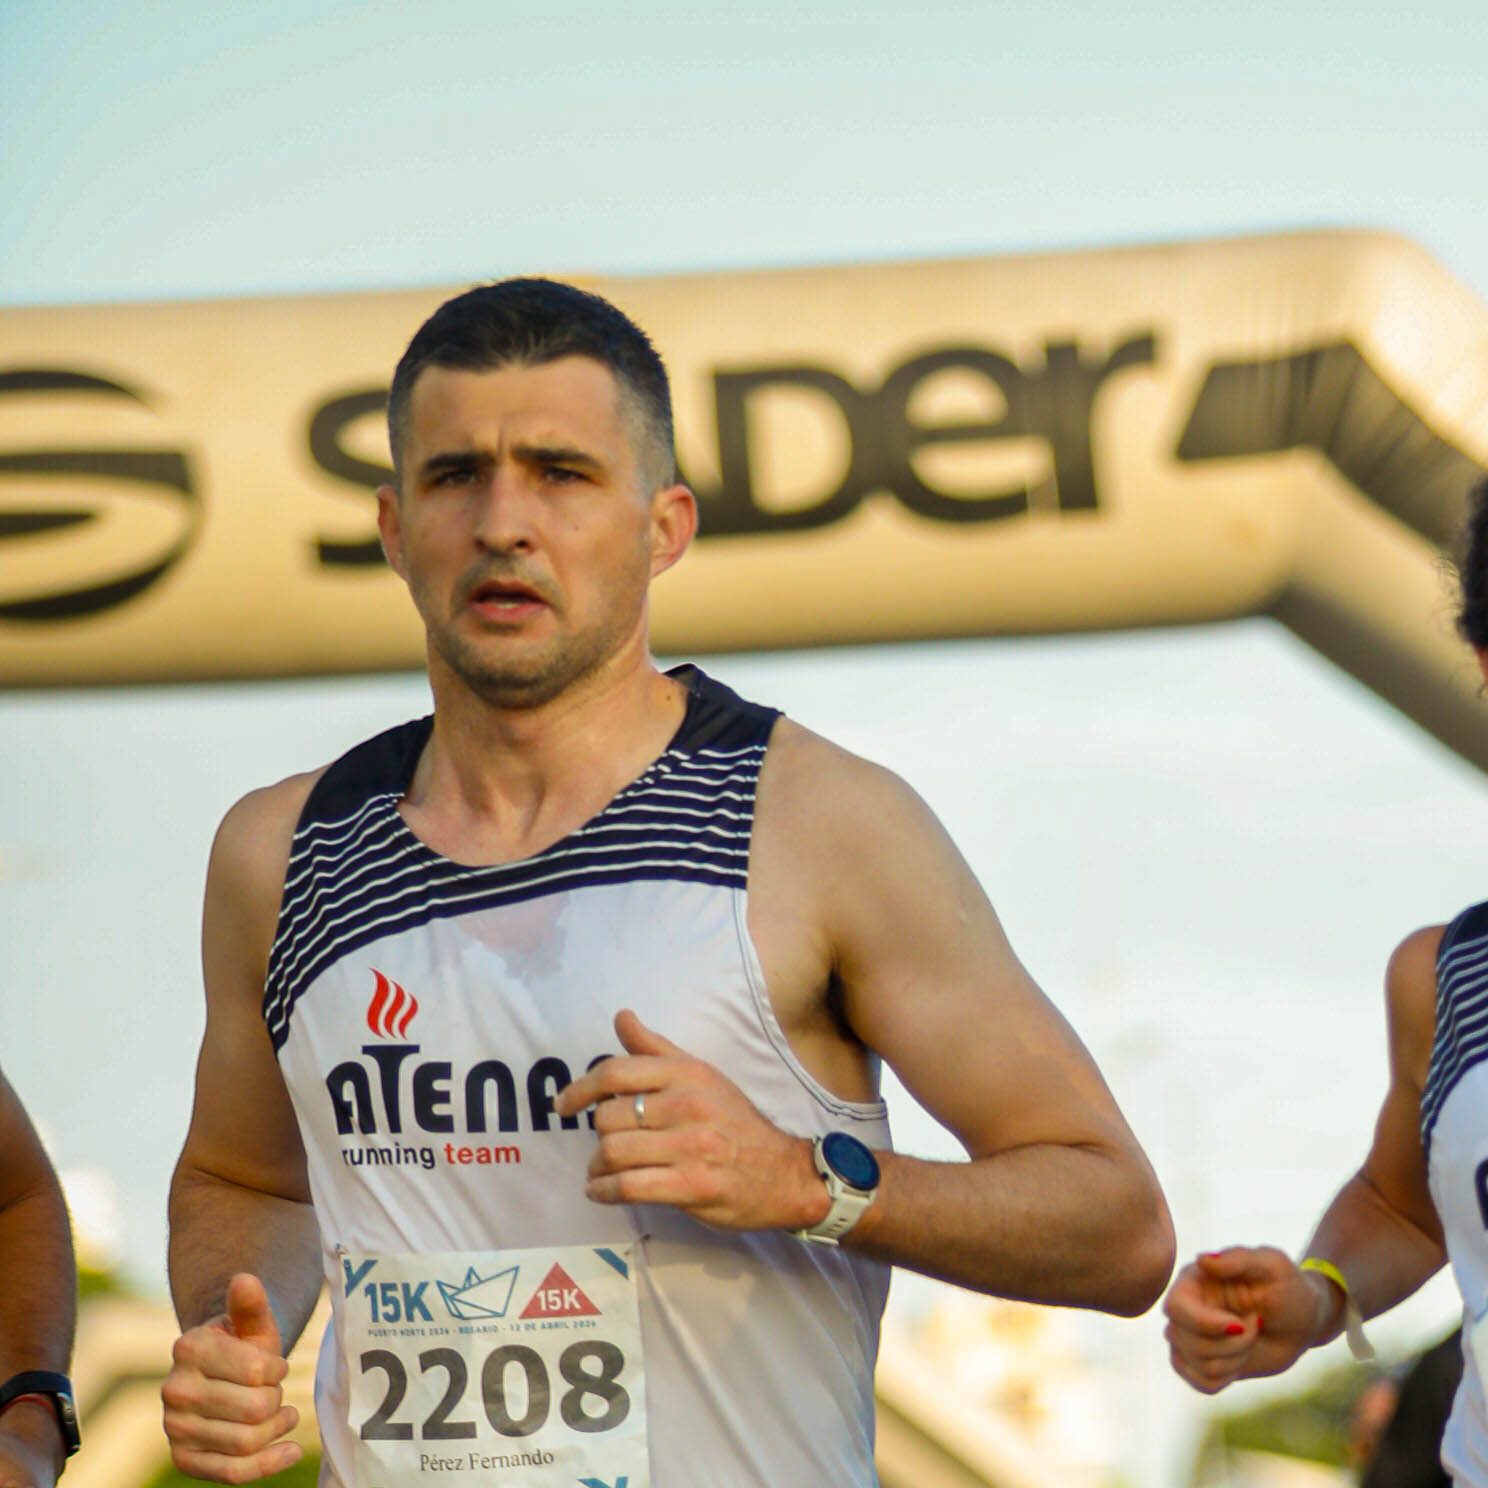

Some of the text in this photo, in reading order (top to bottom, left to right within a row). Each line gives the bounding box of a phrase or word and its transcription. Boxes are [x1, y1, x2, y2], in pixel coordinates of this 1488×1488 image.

[341, 1141, 521, 1169] running team
[364, 1281, 433, 1323] 15K
[534, 1287, 583, 1312] 15K
[359, 1339, 631, 1441] 2208
[419, 1448, 555, 1472] Pérez Fernando
